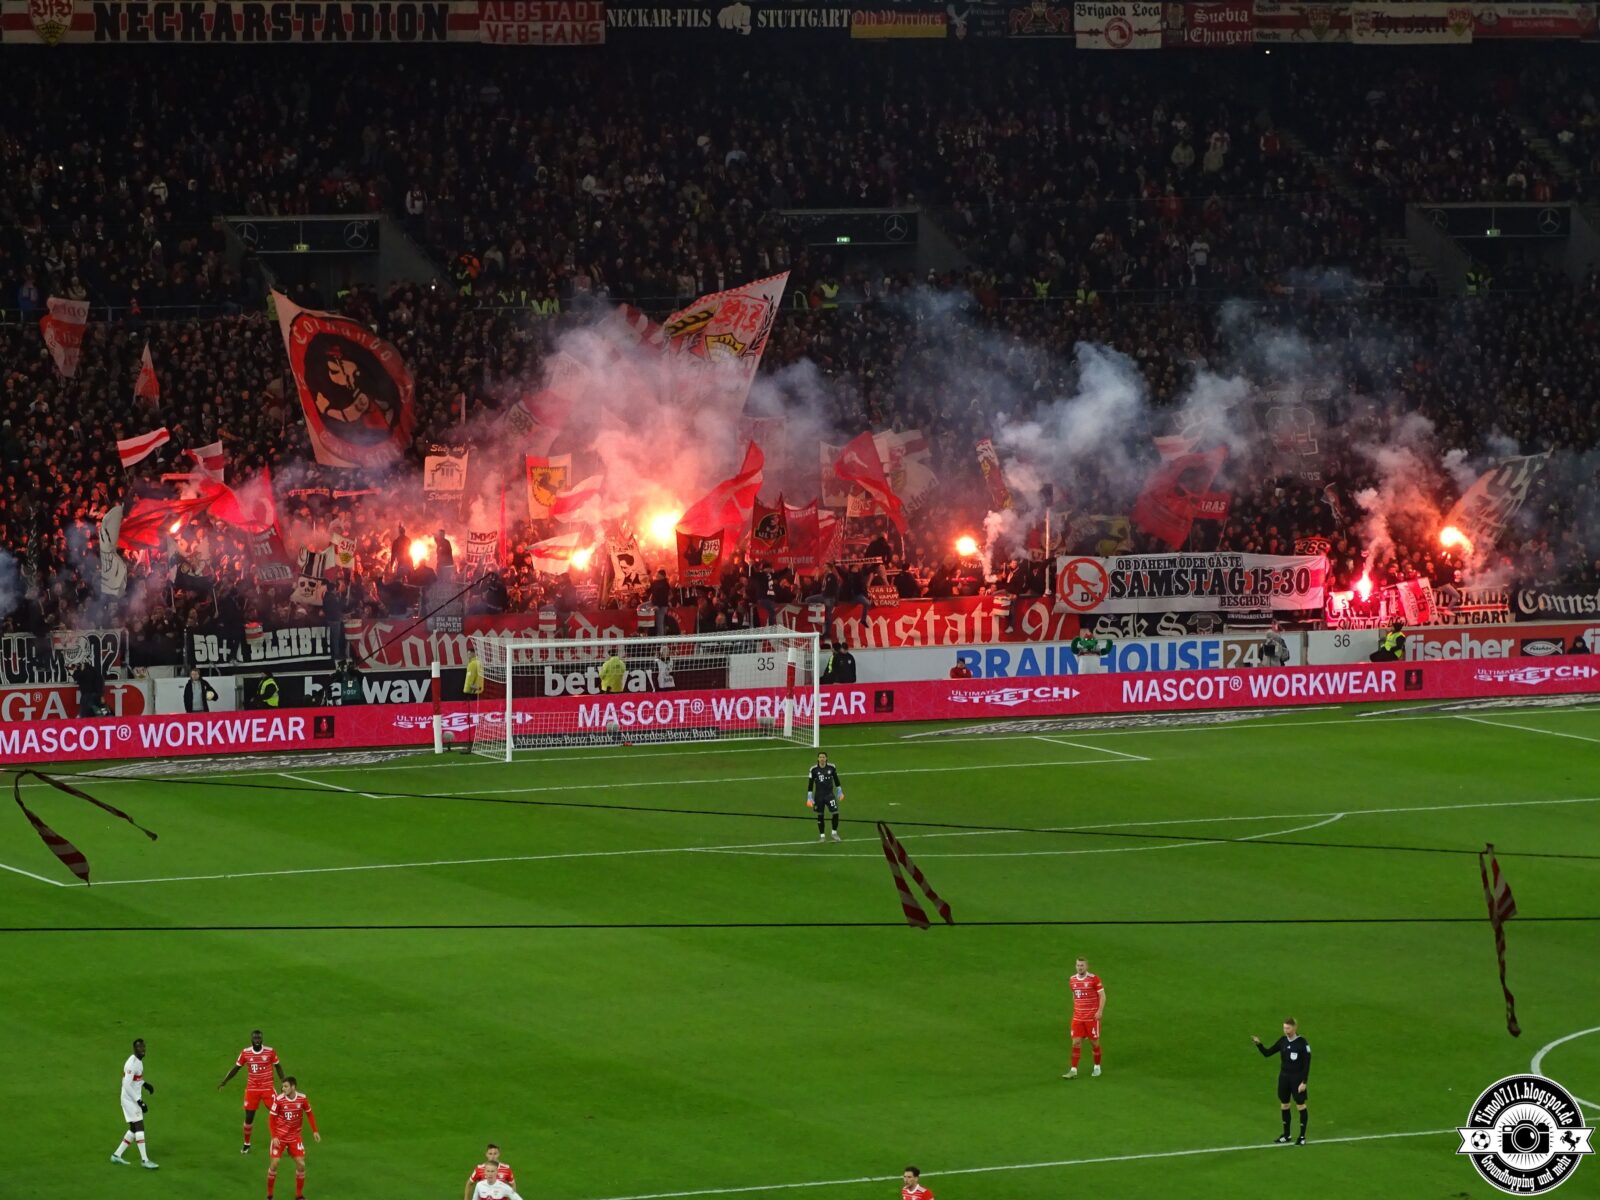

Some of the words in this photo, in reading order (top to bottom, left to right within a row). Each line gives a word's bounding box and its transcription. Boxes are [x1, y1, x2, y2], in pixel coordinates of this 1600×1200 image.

[483, 1, 604, 21] ALBSTADT
[606, 8, 713, 27] NECKAR-FILS
[757, 9, 851, 28] STUTTGART
[1076, 4, 1126, 19] Brigada
[1132, 3, 1161, 17] Loca
[94, 2, 449, 42] NECKARSTADION
[486, 23, 602, 41] VFB-FANS
[1117, 559, 1132, 571] OB
[1133, 558, 1177, 570] DAHEIM
[1178, 557, 1205, 569] ODER
[1110, 567, 1246, 599] SAMSTAG
[1250, 567, 1311, 596] 15:30
[250, 626, 332, 661] BLEIBT!
[1333, 634, 1351, 648] 36
[1404, 633, 1515, 661] fischer
[757, 656, 775, 671] 35
[1249, 668, 1397, 698] WORKWEAR
[1478, 666, 1589, 683] STRETCH
[949, 687, 1072, 704] STRETCH
[711, 690, 867, 722] WORKWEAR
[138, 716, 305, 749] WORKWEAR
[589, 733, 614, 743] Bank
[692, 728, 718, 739] Bank
